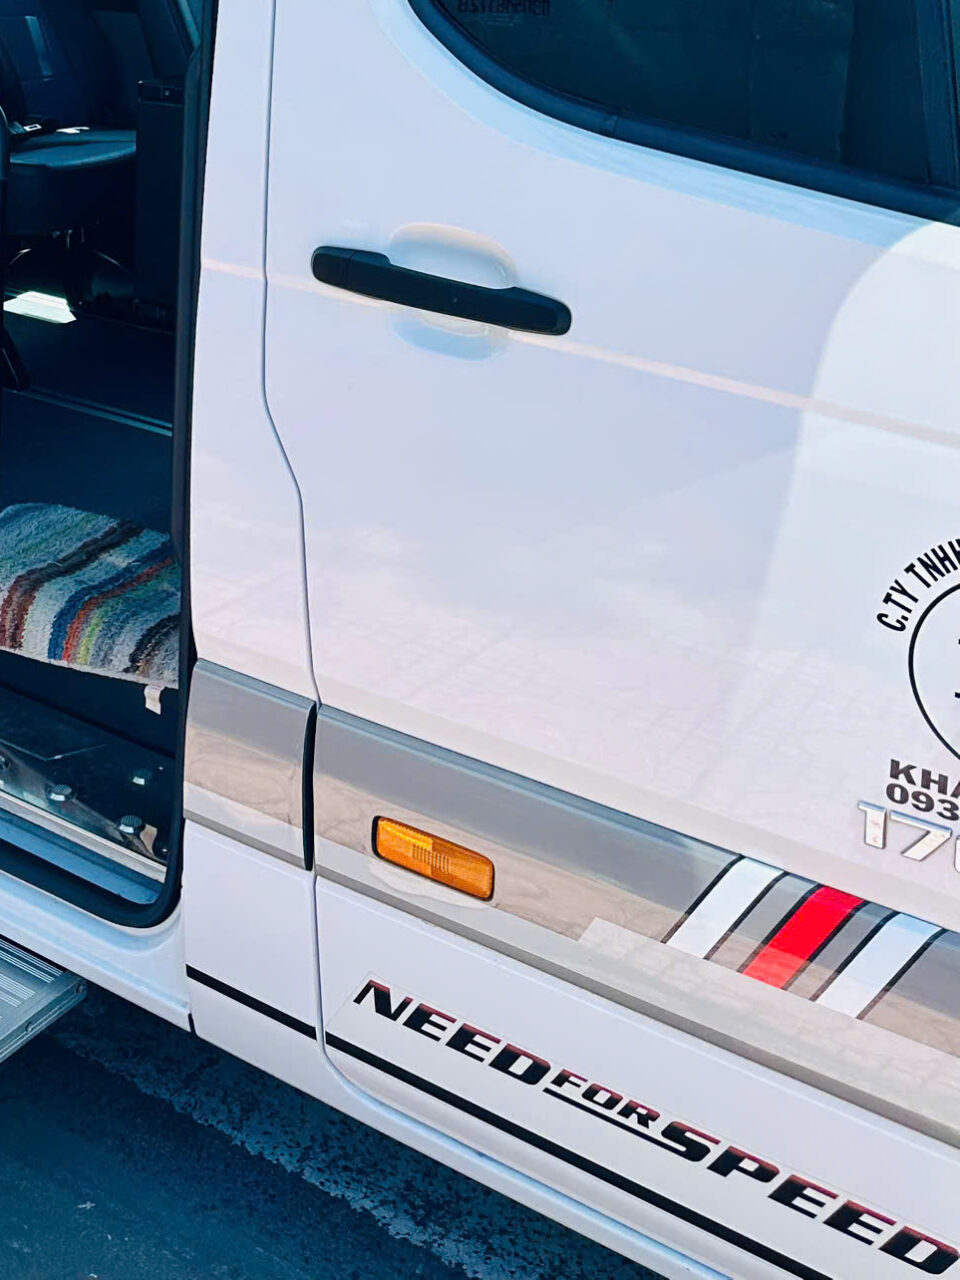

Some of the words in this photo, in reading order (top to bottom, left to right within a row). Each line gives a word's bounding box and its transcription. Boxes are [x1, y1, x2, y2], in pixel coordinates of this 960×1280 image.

[876, 578, 919, 632] C.TY
[353, 978, 552, 1087] NEED
[548, 1068, 661, 1130] FOR
[659, 1120, 960, 1276] SPEED
